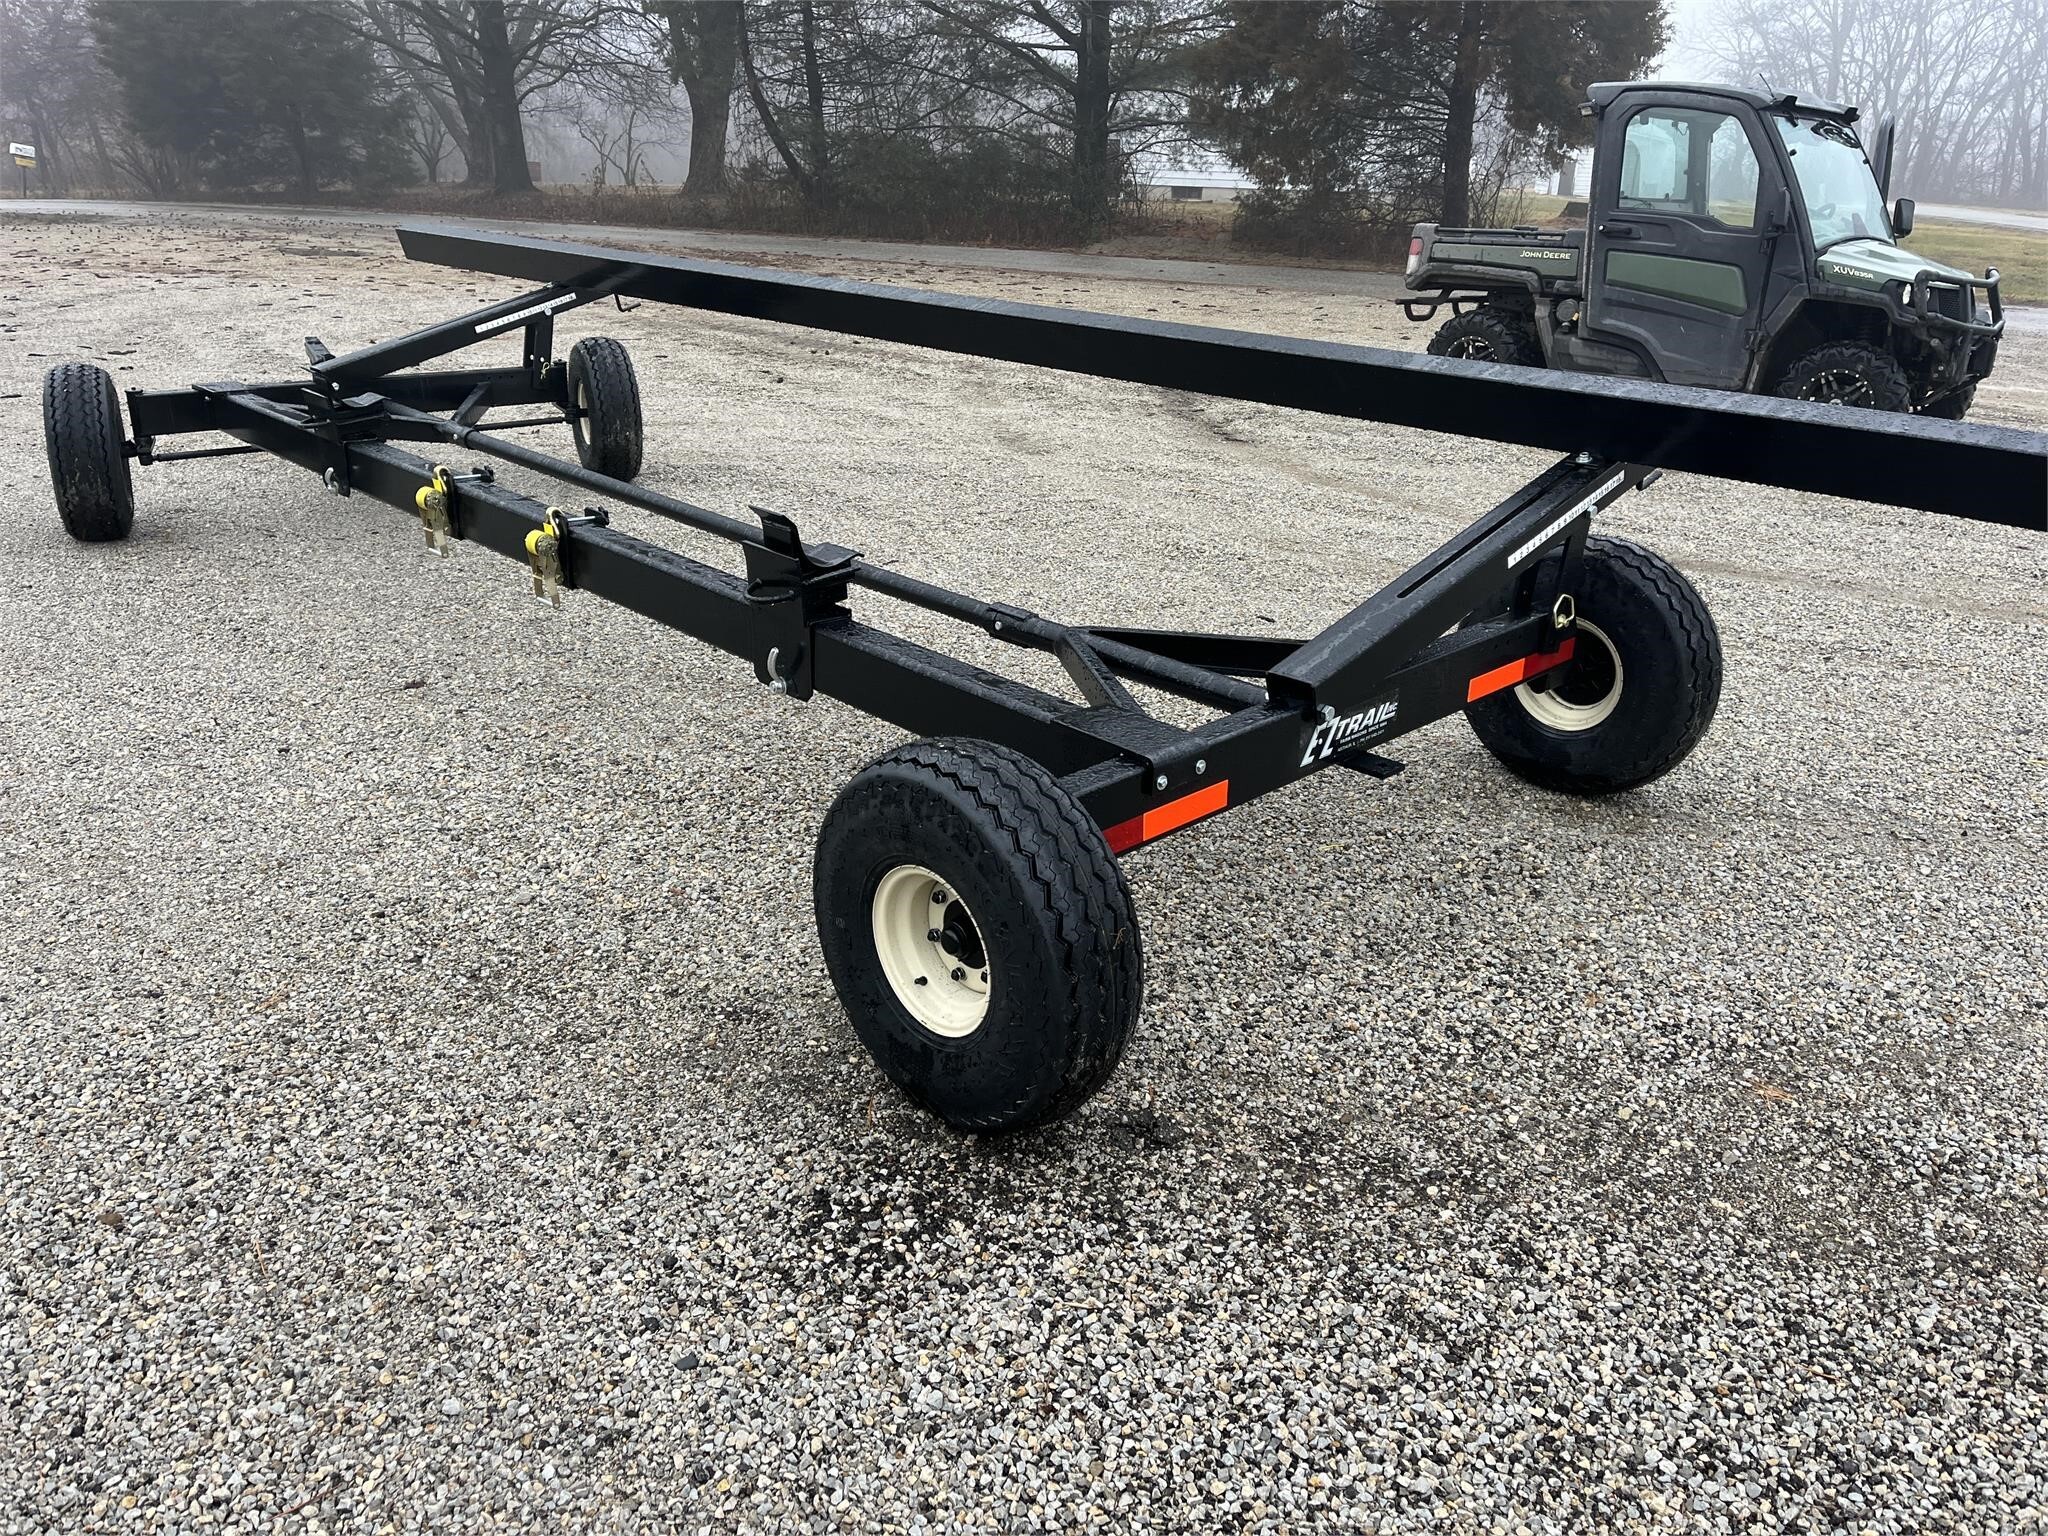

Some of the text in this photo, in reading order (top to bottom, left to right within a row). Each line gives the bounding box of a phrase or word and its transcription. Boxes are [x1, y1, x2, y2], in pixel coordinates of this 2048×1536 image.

[1519, 250, 1572, 260] JOHN DEERE
[1335, 701, 1396, 740] TRAIL
